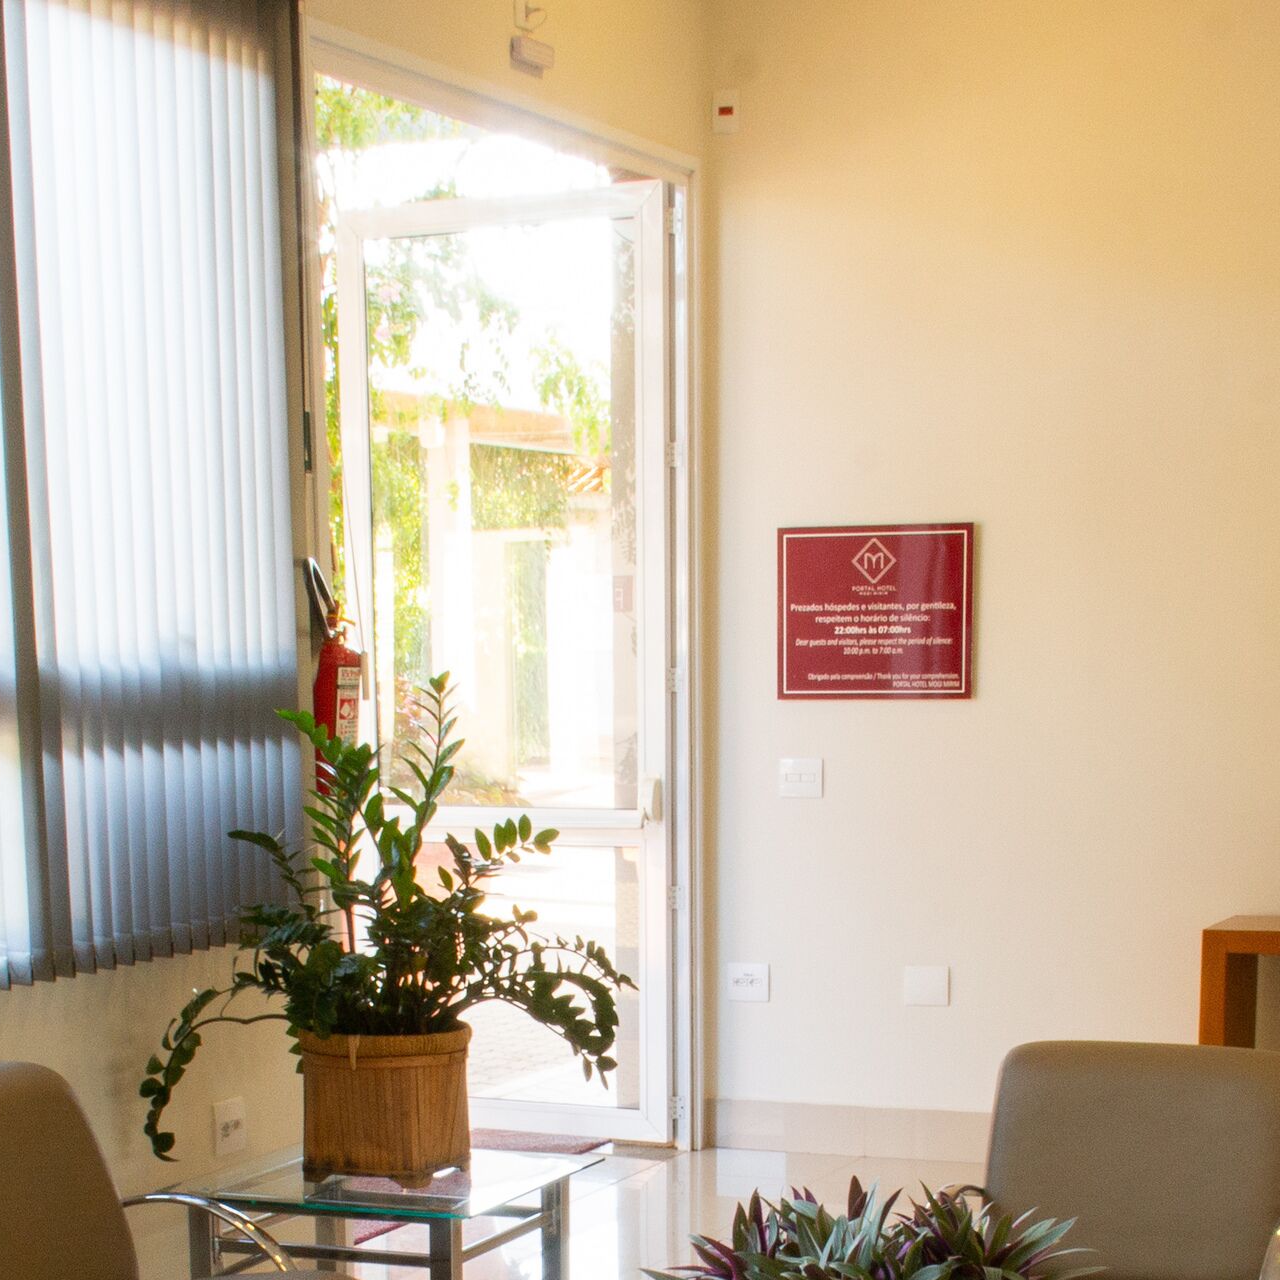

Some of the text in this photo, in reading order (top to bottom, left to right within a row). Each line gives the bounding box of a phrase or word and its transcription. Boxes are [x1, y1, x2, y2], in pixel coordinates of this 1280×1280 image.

[790, 603, 823, 612] Prezados
[824, 602, 860, 613] hóspedes
[867, 602, 904, 612] visitantes,
[906, 603, 919, 612] por
[921, 601, 957, 612] gentileza,
[815, 614, 852, 624] respeitem
[860, 613, 888, 623] horário
[889, 613, 899, 622] de
[900, 613, 931, 622] silêncio:
[834, 625, 911, 635] 22:00hrs às 07:00hrs
[795, 638, 809, 647] Dear
[827, 637, 838, 646] and
[898, 637, 907, 645] the
[926, 636, 933, 647] of
